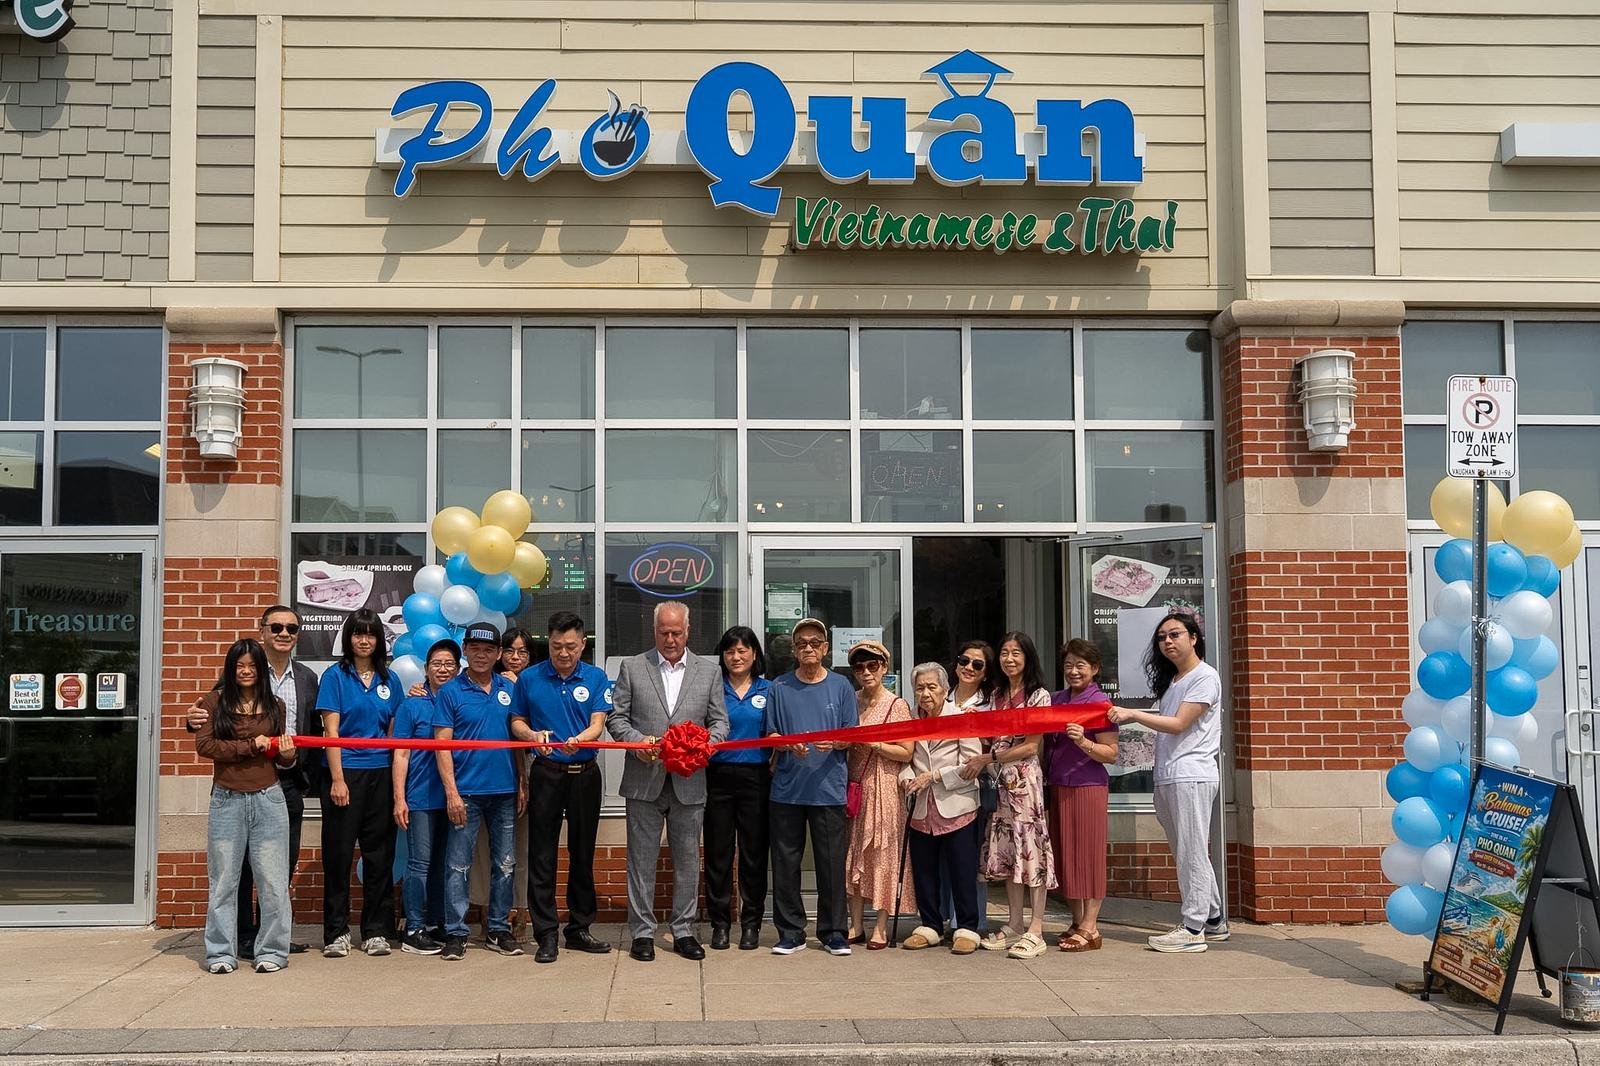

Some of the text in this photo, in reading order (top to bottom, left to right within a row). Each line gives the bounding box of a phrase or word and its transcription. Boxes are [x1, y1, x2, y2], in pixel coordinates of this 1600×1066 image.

[795, 196, 1180, 253] Vietnamese & Thai
[1452, 379, 1512, 392] FIRE ROUTE
[1475, 400, 1493, 424] P
[1452, 431, 1513, 444] TOW AWAY
[1466, 444, 1497, 457] ZONE
[367, 564, 392, 572] SPRING
[393, 564, 412, 572] ROLLS
[634, 558, 706, 584] OPEN
[6, 607, 137, 632] Treasure
[102, 675, 115, 685] CV
[12, 697, 41, 705] Awards
[14, 690, 39, 698] Best of
[1502, 782, 1524, 797] WIN A
[1484, 792, 1533, 817] Bahamas
[1483, 811, 1528, 833] CRUISE!
[1477, 837, 1517, 860] PHO QUAN
